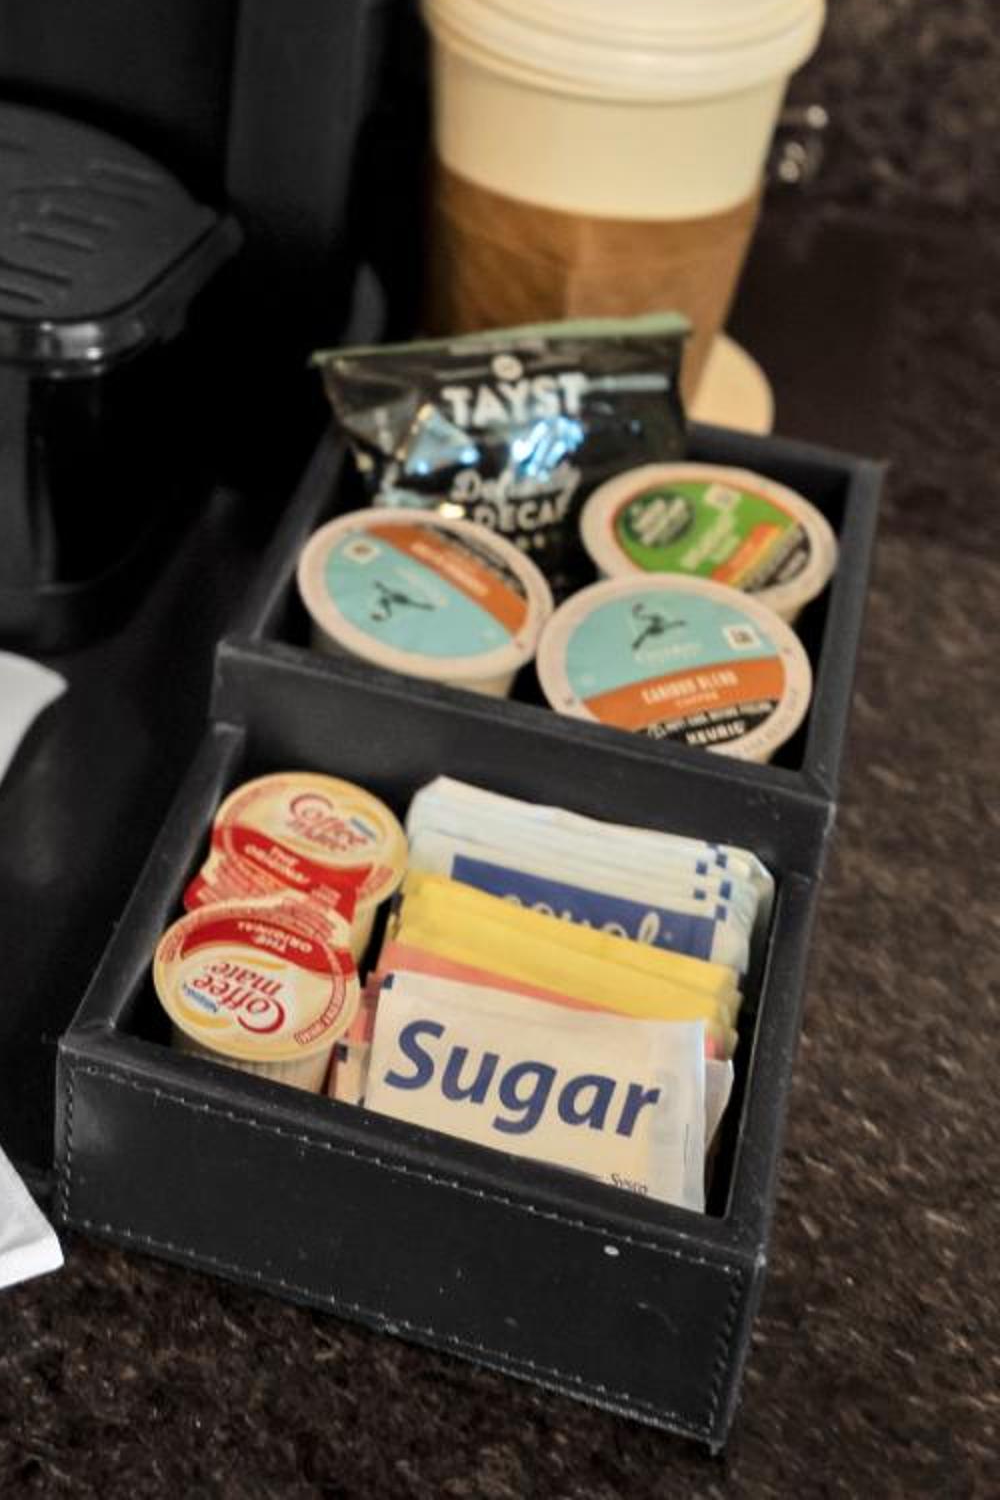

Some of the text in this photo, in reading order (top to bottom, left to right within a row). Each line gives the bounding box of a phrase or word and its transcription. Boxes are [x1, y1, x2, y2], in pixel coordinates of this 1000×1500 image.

[441, 372, 588, 427] TAYST
[193, 974, 287, 1035] Coffee
[211, 962, 284, 998] mate
[384, 1018, 661, 1138] Sugar
